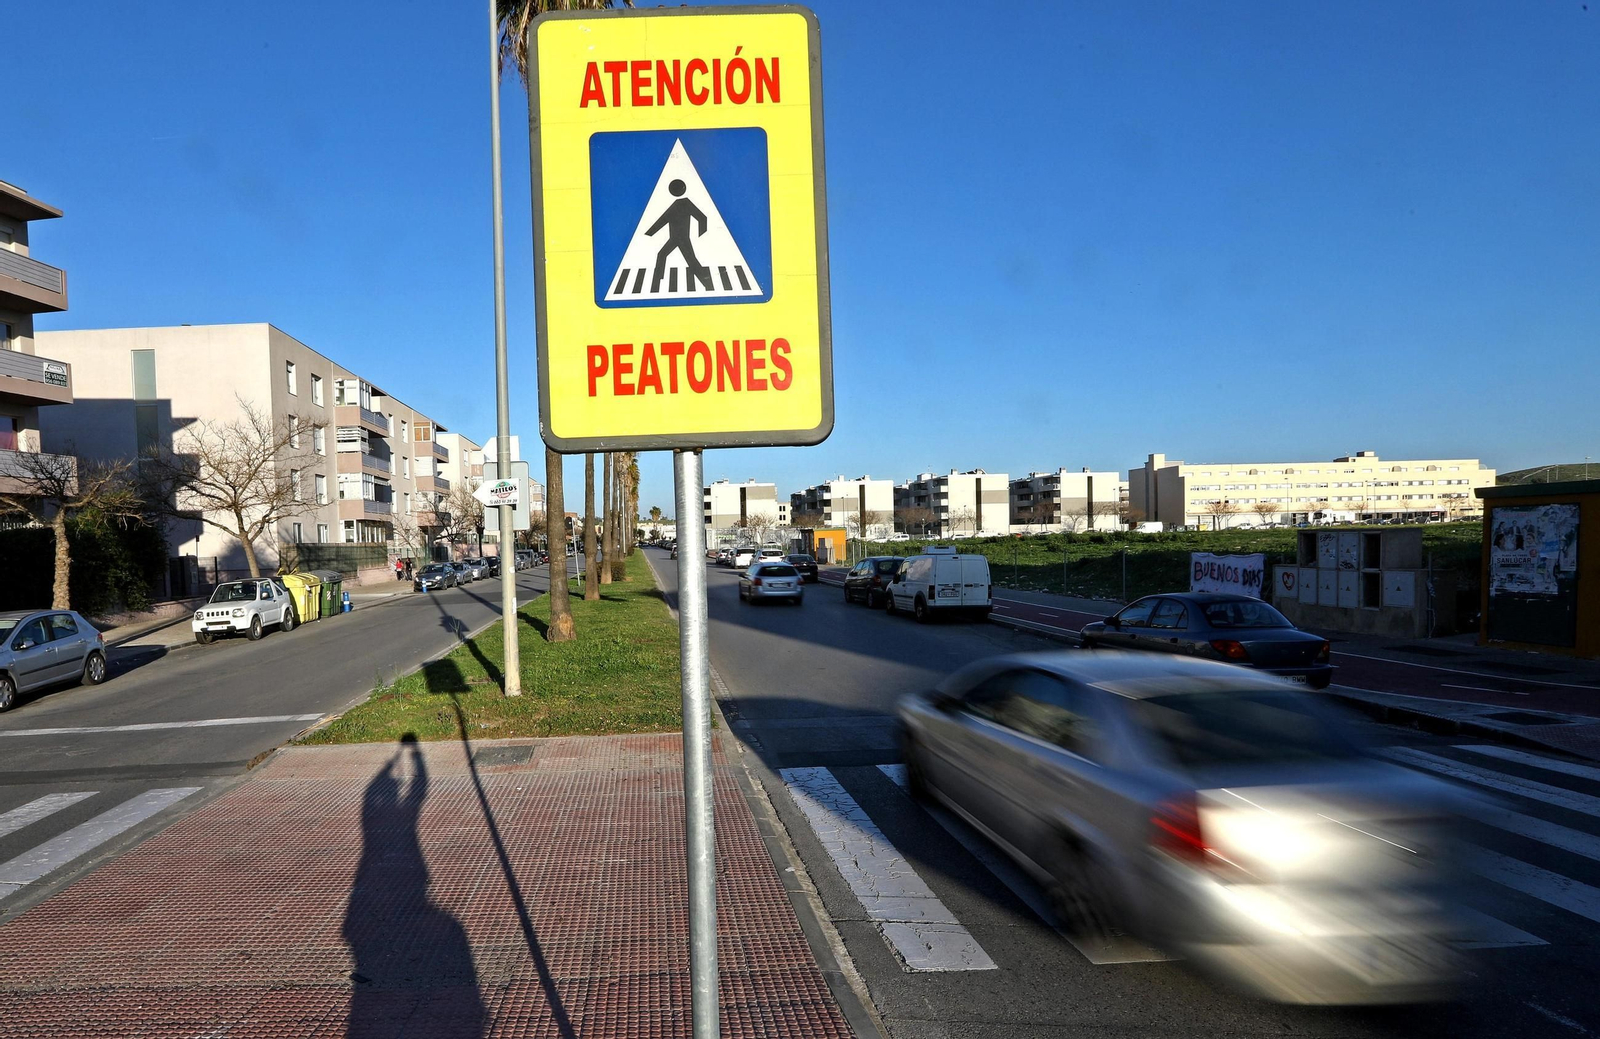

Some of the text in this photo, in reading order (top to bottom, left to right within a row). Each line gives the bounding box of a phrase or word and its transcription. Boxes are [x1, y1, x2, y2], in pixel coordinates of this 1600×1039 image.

[580, 46, 781, 108] ATENCIÓN
[51, 373, 67, 382] VENDE
[587, 338, 793, 397] PEATONES
[1194, 561, 1239, 583] BUENOS
